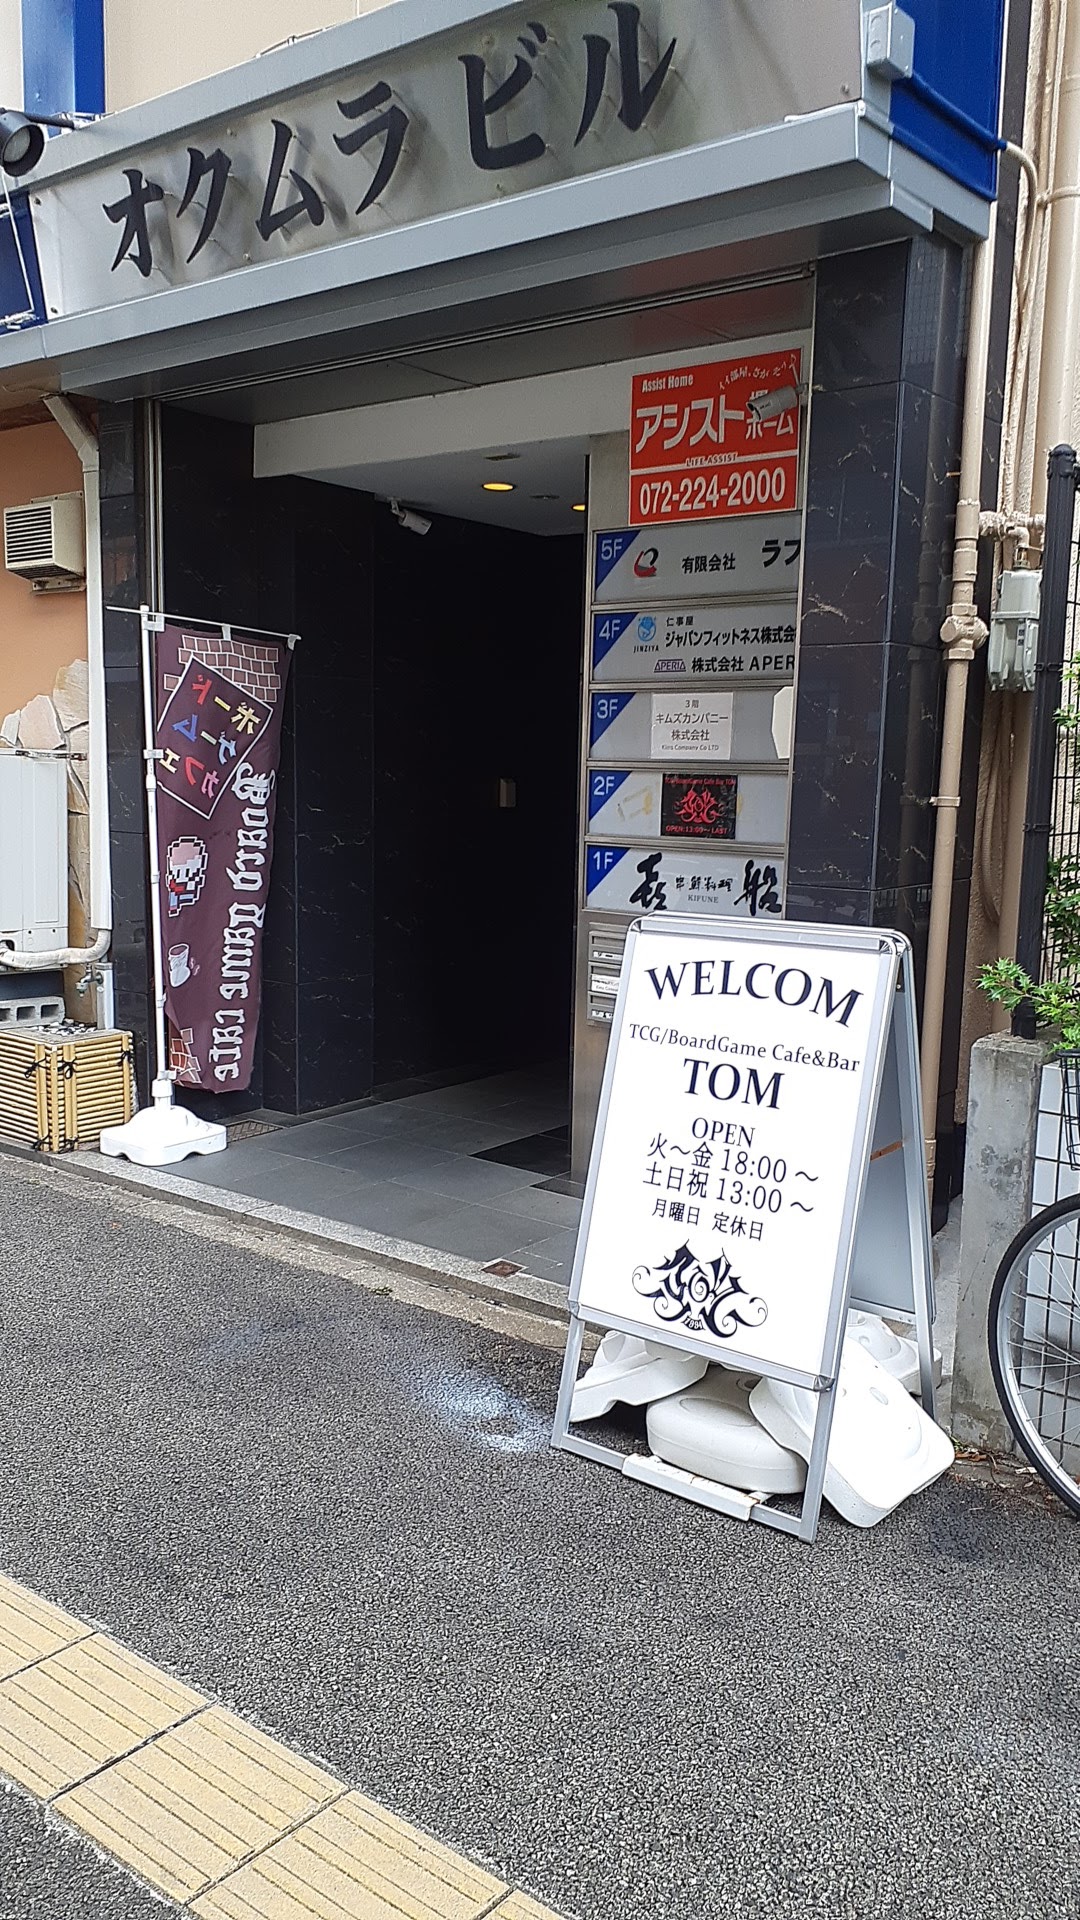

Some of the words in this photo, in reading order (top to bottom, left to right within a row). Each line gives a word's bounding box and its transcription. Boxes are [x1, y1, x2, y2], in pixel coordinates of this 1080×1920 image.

[641, 375, 666, 393] Assist
[668, 373, 694, 388] Home
[636, 393, 745, 453] アシスト
[685, 457, 704, 467] LIFE
[707, 452, 738, 465] ASSIST
[639, 466, 785, 516] 072-224-2000
[601, 538, 623, 560] 5F
[682, 552, 736, 574] 有限会社
[599, 619, 621, 641] 4F
[666, 615, 694, 627] 仁事屋
[665, 624, 797, 648] ジャパンフィットネス株式会
[633, 644, 660, 653] JINZIYA
[655, 659, 686, 673] APERIA
[692, 655, 744, 674] 株式会社
[597, 698, 618, 719] 3F
[655, 711, 729, 724] キムズカンパニー
[671, 728, 710, 741] 株式会社
[593, 776, 615, 795] 2F
[592, 851, 613, 870] 1F
[687, 894, 719, 904] KIFUNE
[644, 960, 864, 1028] WELCOM
[629, 1023, 767, 1059] TCG/BoardGame
[772, 1043, 861, 1073] Cafe&Bar
[683, 1057, 786, 1110] TOM
[691, 1117, 756, 1149] OPEN
[642, 1161, 710, 1199] 土日祝
[651, 1197, 701, 1226] 月曜日
[711, 1211, 764, 1242] 定休日
